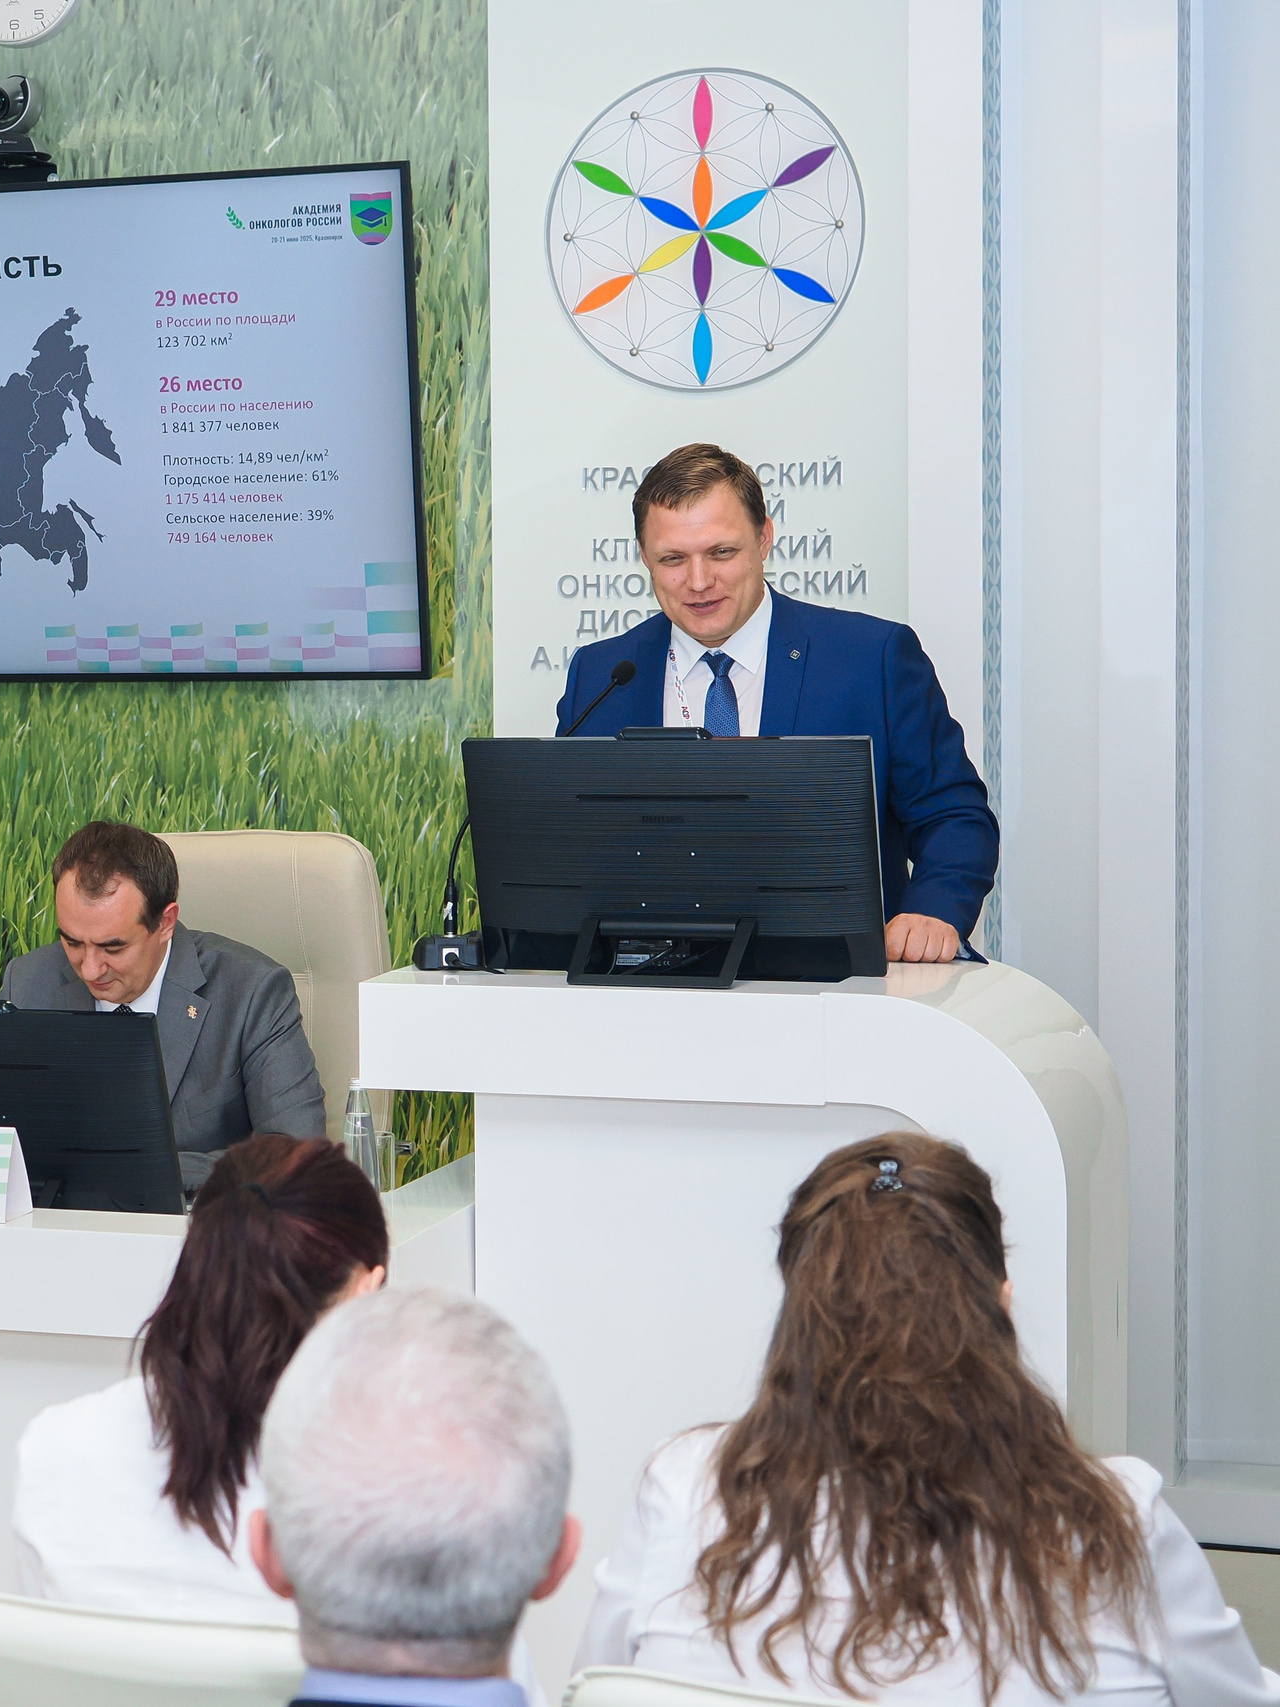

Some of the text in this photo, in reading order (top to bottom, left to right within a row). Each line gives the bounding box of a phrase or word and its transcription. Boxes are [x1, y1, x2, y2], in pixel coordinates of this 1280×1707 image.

[9, 20, 19, 30] 6
[292, 203, 342, 216] АКАДЕМИЯ
[249, 216, 342, 230] ОНКОЛОГОВ РОССИИ
[155, 290, 239, 307] 29 место
[156, 313, 296, 328] в России по площади
[157, 336, 179, 348] 123
[184, 335, 206, 347] 702
[159, 376, 243, 393] 26 место
[160, 400, 314, 414] в России по населению
[161, 420, 280, 433] 1 841 377 человек
[163, 454, 234, 466] Плотность:
[238, 452, 273, 465] 14,89
[164, 470, 340, 487] Городское население: 61%
[581, 455, 842, 491] КРАСКИЙ
[166, 492, 284, 505] 1 175 414 человек
[166, 509, 334, 524] Сельское население: 39%
[167, 532, 274, 544] 749 164 человек
[557, 563, 868, 598] ОНКОСКИЙ
